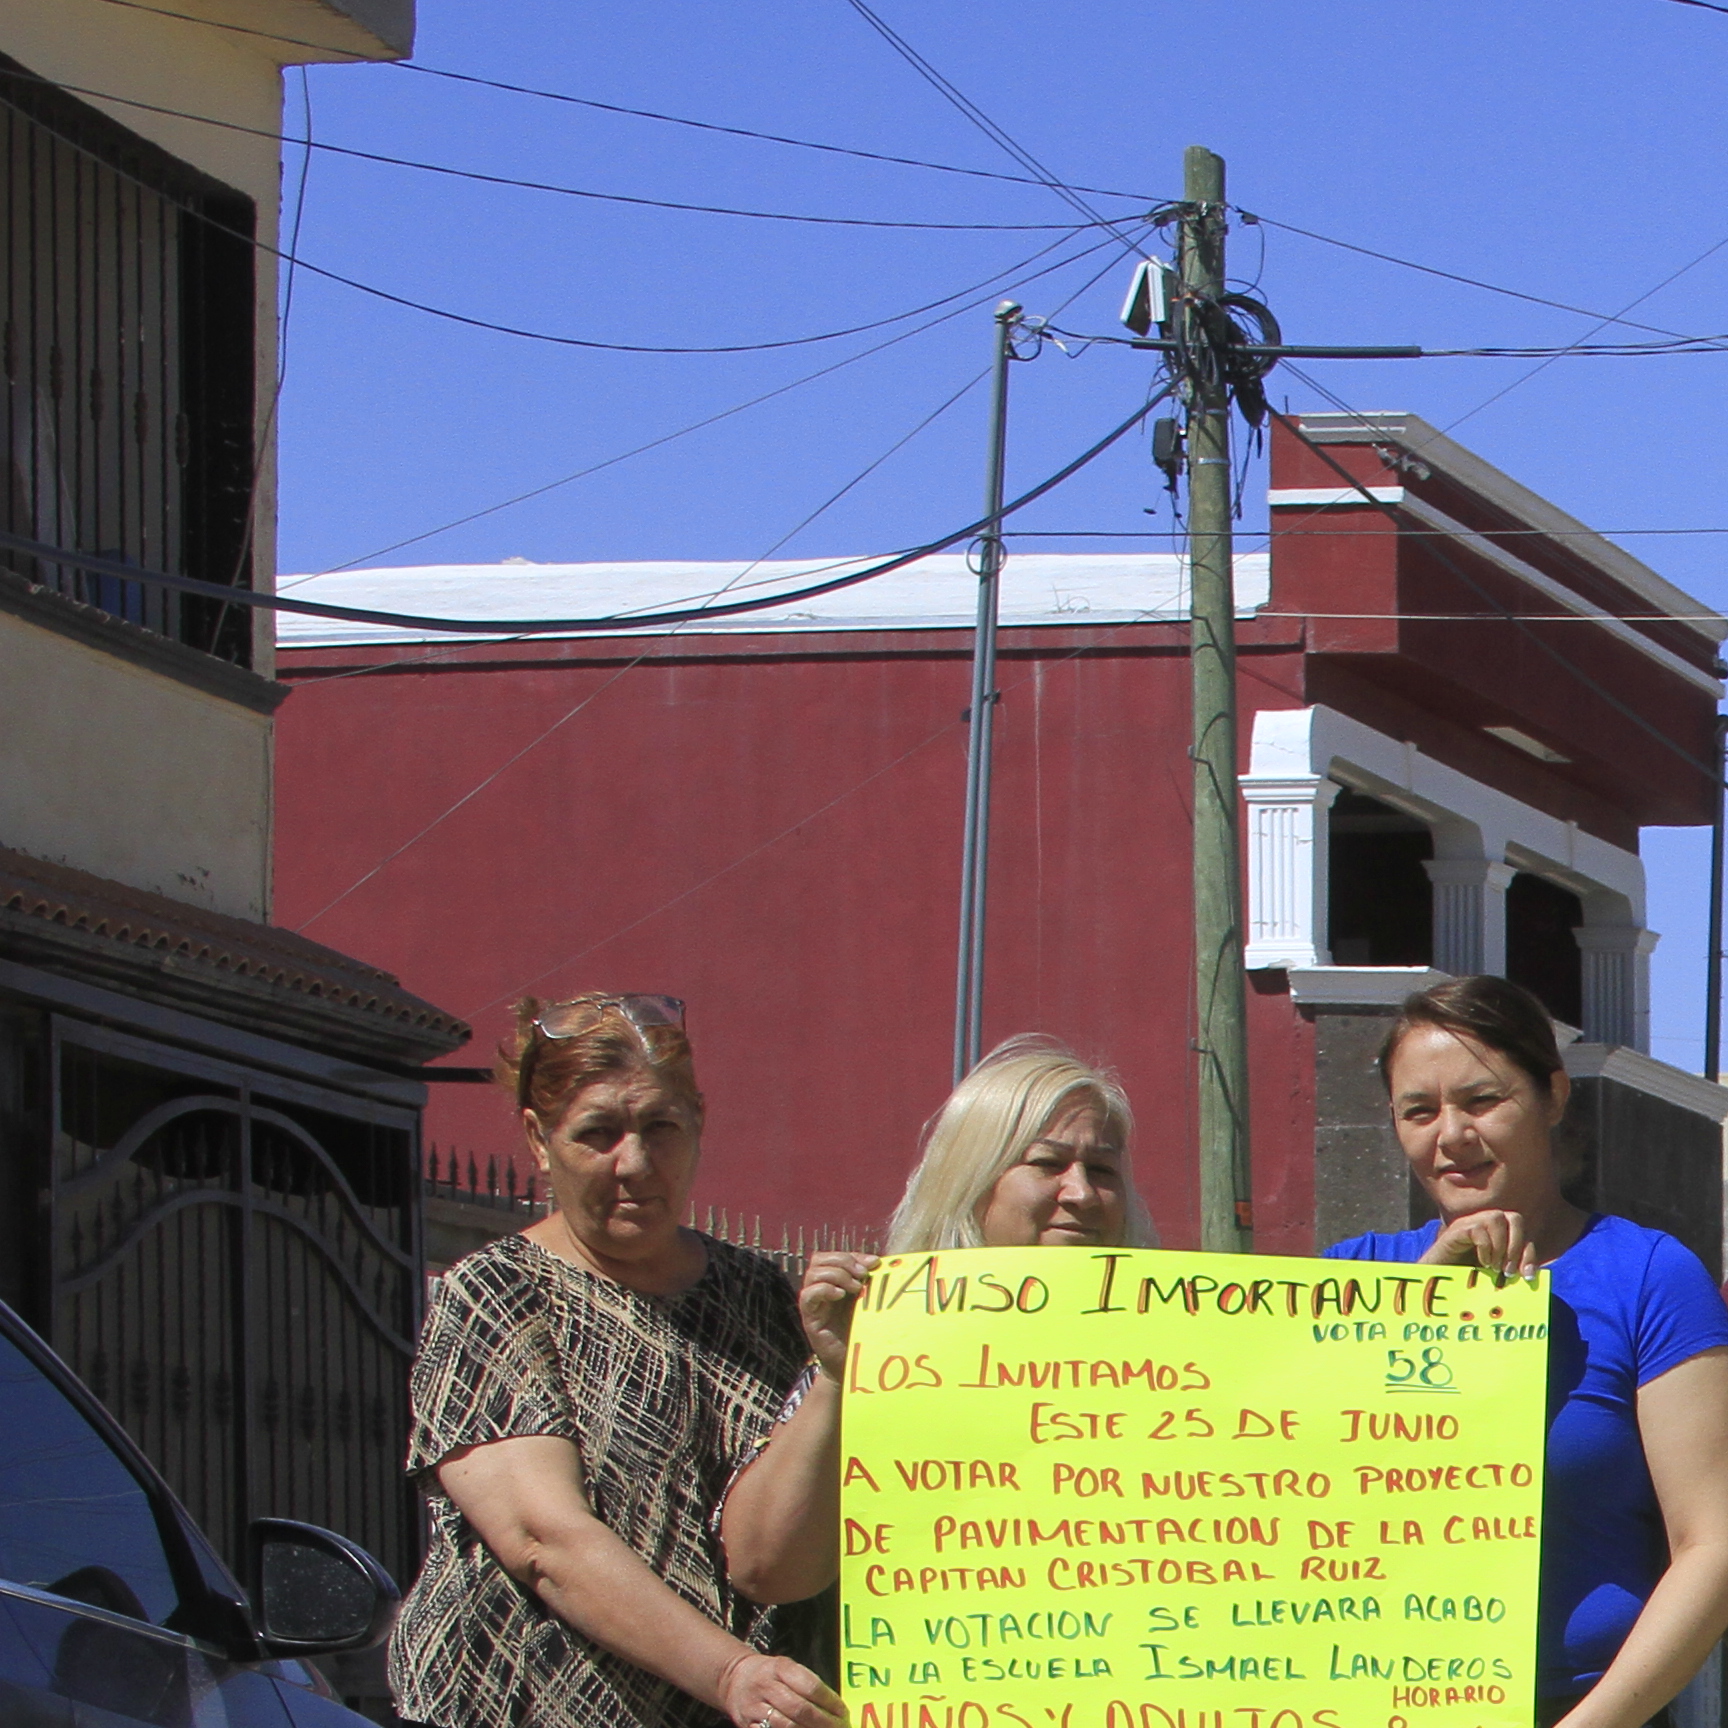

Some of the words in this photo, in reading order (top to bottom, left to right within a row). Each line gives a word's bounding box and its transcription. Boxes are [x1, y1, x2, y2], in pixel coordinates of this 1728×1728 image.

[1312, 1322, 1387, 1344] VOTA
[1403, 1322, 1449, 1343] POR
[1456, 1322, 1484, 1343] EL
[1492, 1321, 1549, 1342] FOLIO
[849, 1341, 943, 1394] LOS
[957, 1343, 1212, 1393] INVITAMOS
[1384, 1345, 1454, 1386] 58
[1030, 1401, 1129, 1444] ESTE
[1147, 1407, 1215, 1440] 25
[1231, 1408, 1301, 1441] DE
[1340, 1409, 1461, 1443] JUNIO
[842, 1455, 881, 1493] A
[893, 1458, 1022, 1493] VOTAR
[1052, 1462, 1125, 1498] POR
[1141, 1469, 1332, 1501] NUESTRO
[1352, 1462, 1534, 1496] PROYECTO
[843, 1516, 896, 1557] DE
[932, 1514, 1281, 1553] PAVIMENTACION
[1307, 1518, 1356, 1550] DE
[1379, 1519, 1426, 1545] LA
[1443, 1514, 1538, 1545] CALLE
[865, 1563, 1027, 1597] CAPITAN
[1048, 1556, 1277, 1591] CRISTOBAL
[1299, 1556, 1388, 1582] RUIZ
[843, 1602, 897, 1650] LA
[923, 1608, 1114, 1649] VOTACION
[1148, 1605, 1201, 1633] SE
[1231, 1595, 1383, 1628] LLEVARA
[1404, 1592, 1508, 1624] ACABO
[846, 1658, 892, 1689] EN
[907, 1661, 942, 1685] LA
[960, 1656, 1114, 1682] ESCUELA
[1137, 1643, 1308, 1682] ISMAEL
[1328, 1642, 1514, 1683] LANDEROS
[1393, 1683, 1507, 1709] HORARIO
